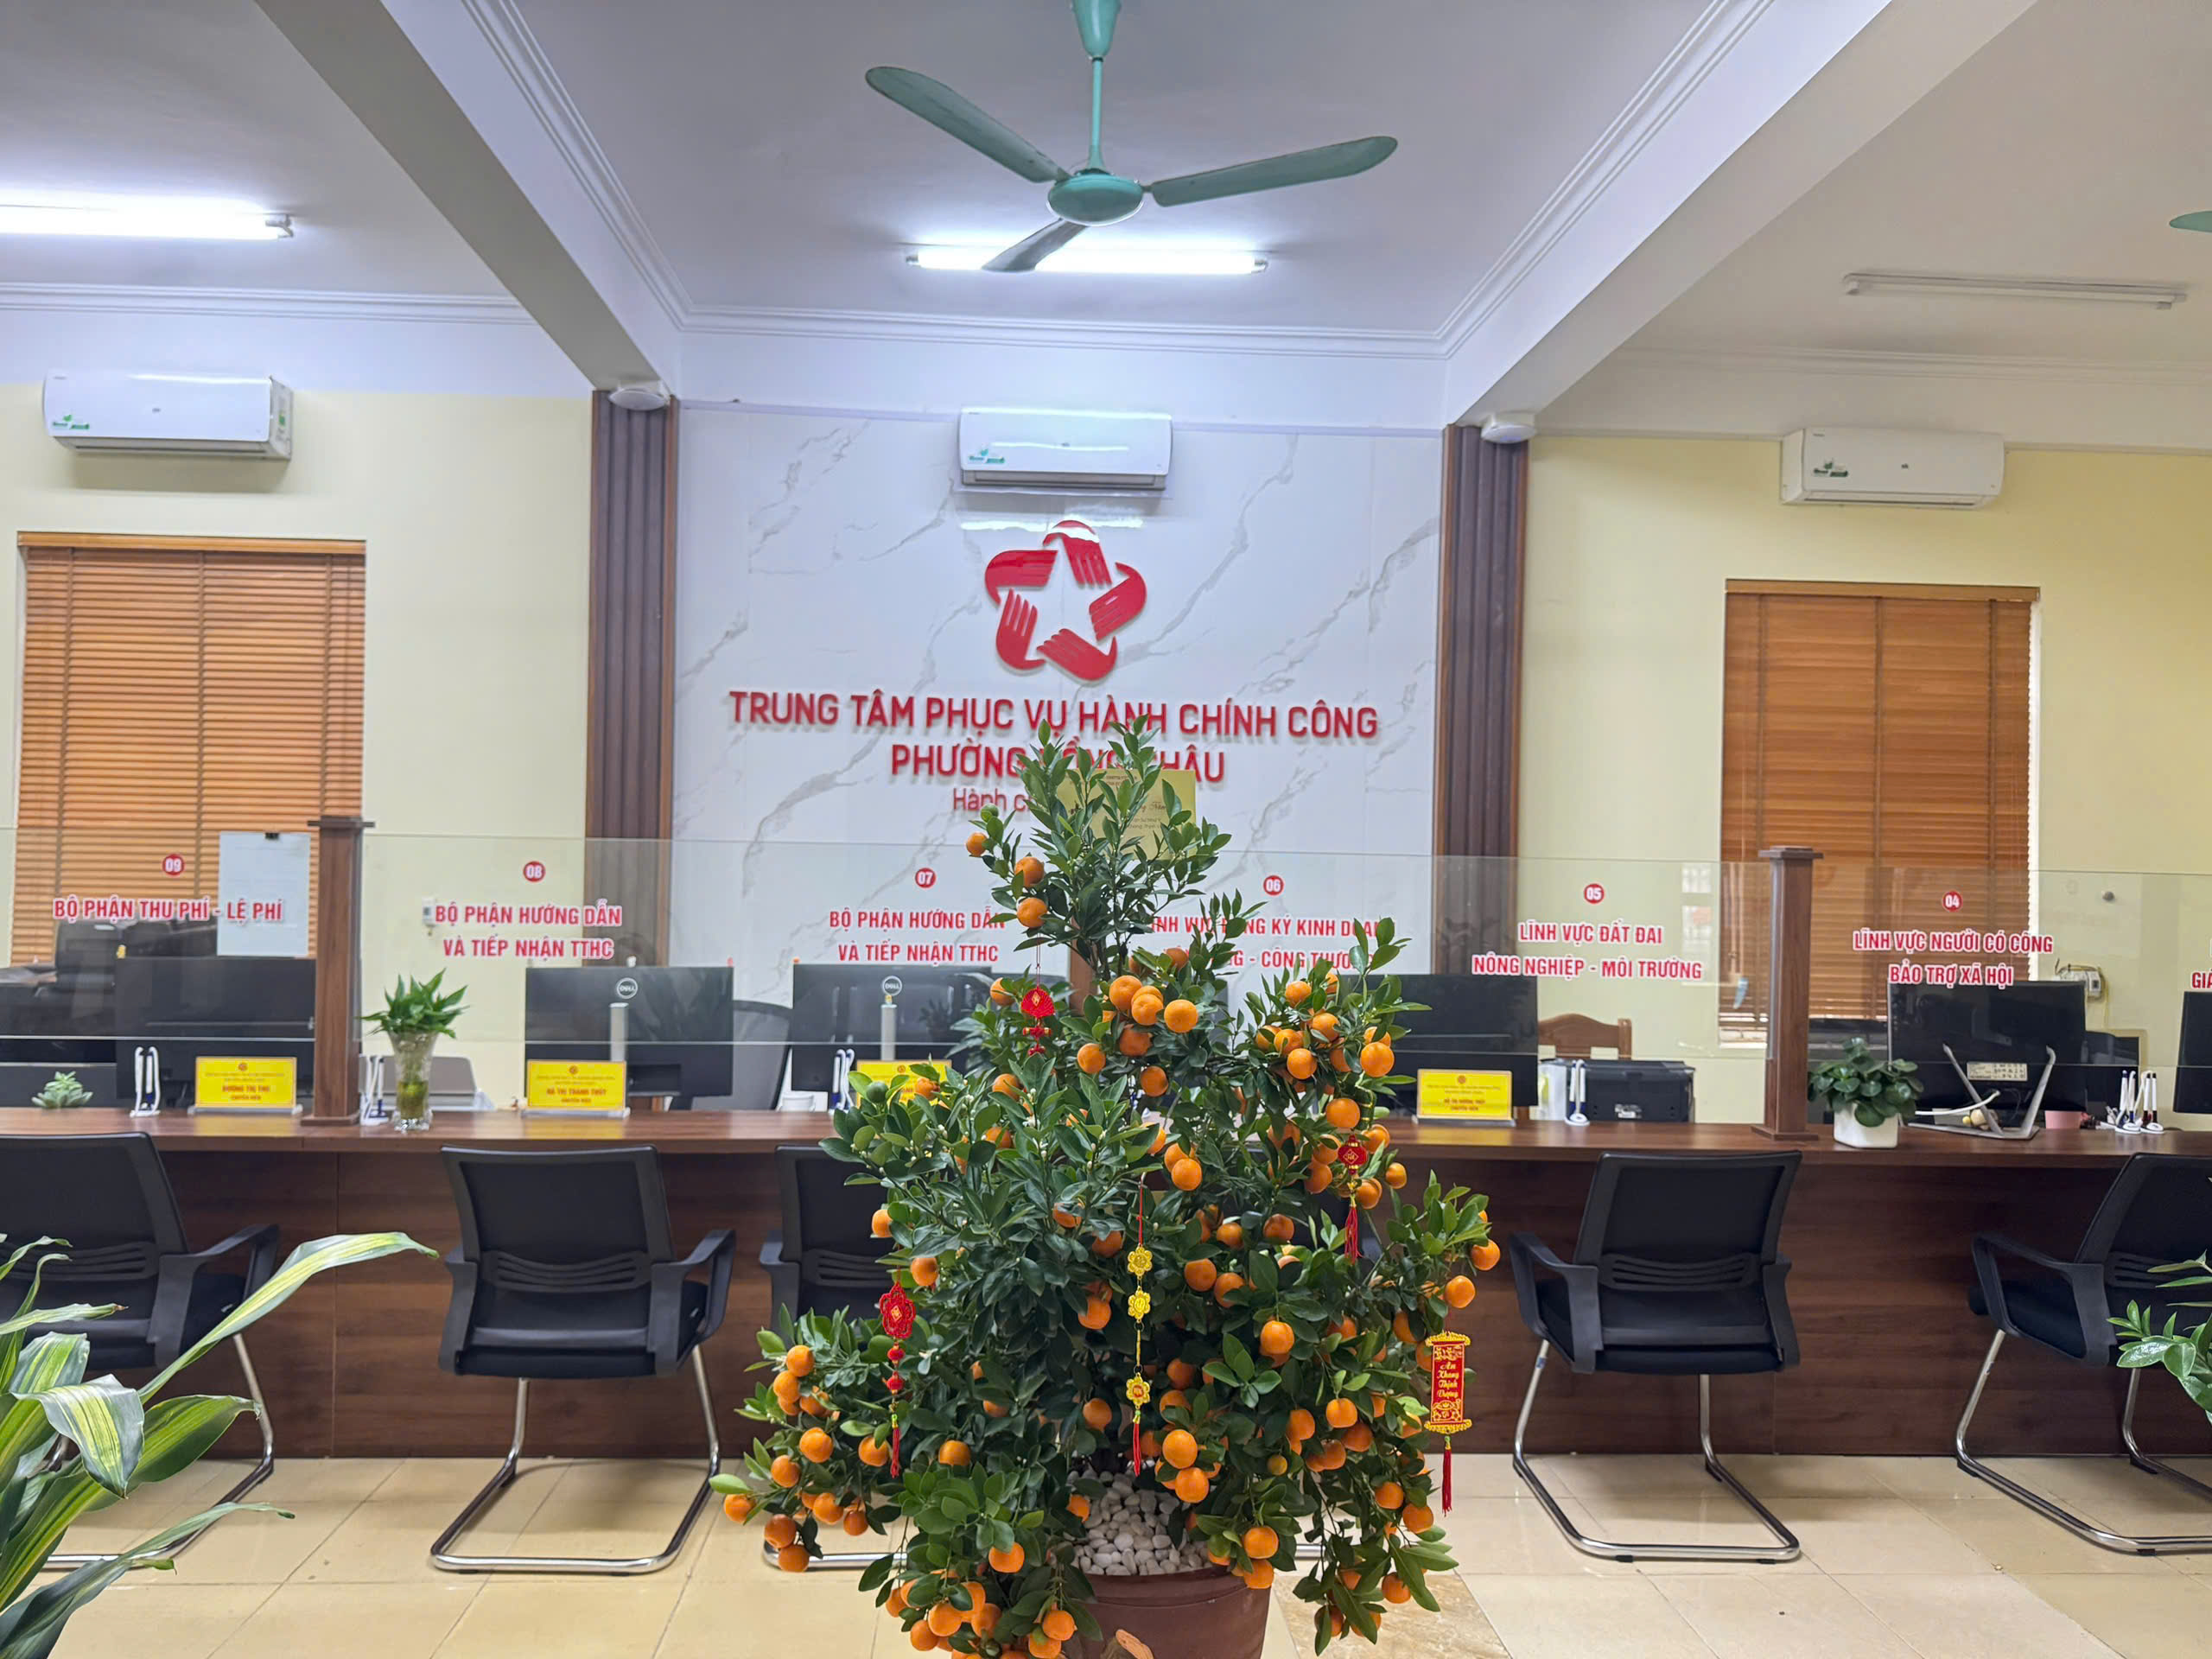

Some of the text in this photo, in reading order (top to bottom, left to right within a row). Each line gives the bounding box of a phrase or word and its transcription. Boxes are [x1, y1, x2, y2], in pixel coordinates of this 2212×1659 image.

[729, 689, 1377, 739] TRUNG TÂM PHỤC VỤ HÀNH CHÍNH CÔNG
[892, 737, 1027, 779] PHƯỜNG
[1154, 744, 1224, 782] HÂU
[953, 788, 1007, 810] Hành
[165, 858, 181, 873] 09
[918, 871, 933, 885] 07
[1266, 880, 1281, 891] 06
[1586, 887, 1602, 900] 05
[54, 895, 78, 922] BỘ
[84, 896, 133, 922] PHẬN
[140, 900, 173, 918] THU
[179, 896, 210, 919] PHÍ
[252, 898, 284, 920] PHÍ
[435, 899, 622, 928] BỘ PHẬN HƯỚNG DẪN
[1945, 895, 1960, 907] 04
[830, 907, 852, 932] BỘ
[857, 907, 903, 932] PHẬN
[909, 909, 965, 929] HƯỚNG
[1272, 914, 1293, 936] KÝ
[1296, 919, 1335, 936] KINH
[1519, 918, 1662, 946] LĨNH VỰC ĐẤT ĐAI
[442, 933, 614, 962] VÀ TIẾP NHẬN TTHC
[838, 938, 999, 965] VÀ TIẾP NHẬN TTHC
[1853, 927, 2053, 954] LĨNH VỰC NGƯỜI CÓ CÔNG
[1262, 947, 1306, 968] CÔNG
[1472, 952, 1521, 975] NÔNG
[1524, 955, 1585, 980] NGHIỆP
[1601, 957, 1633, 977] MÔI
[1637, 957, 1702, 979] TRƯỜNG
[1889, 959, 2013, 988] BẢO TRỢ XÃ HỘI
